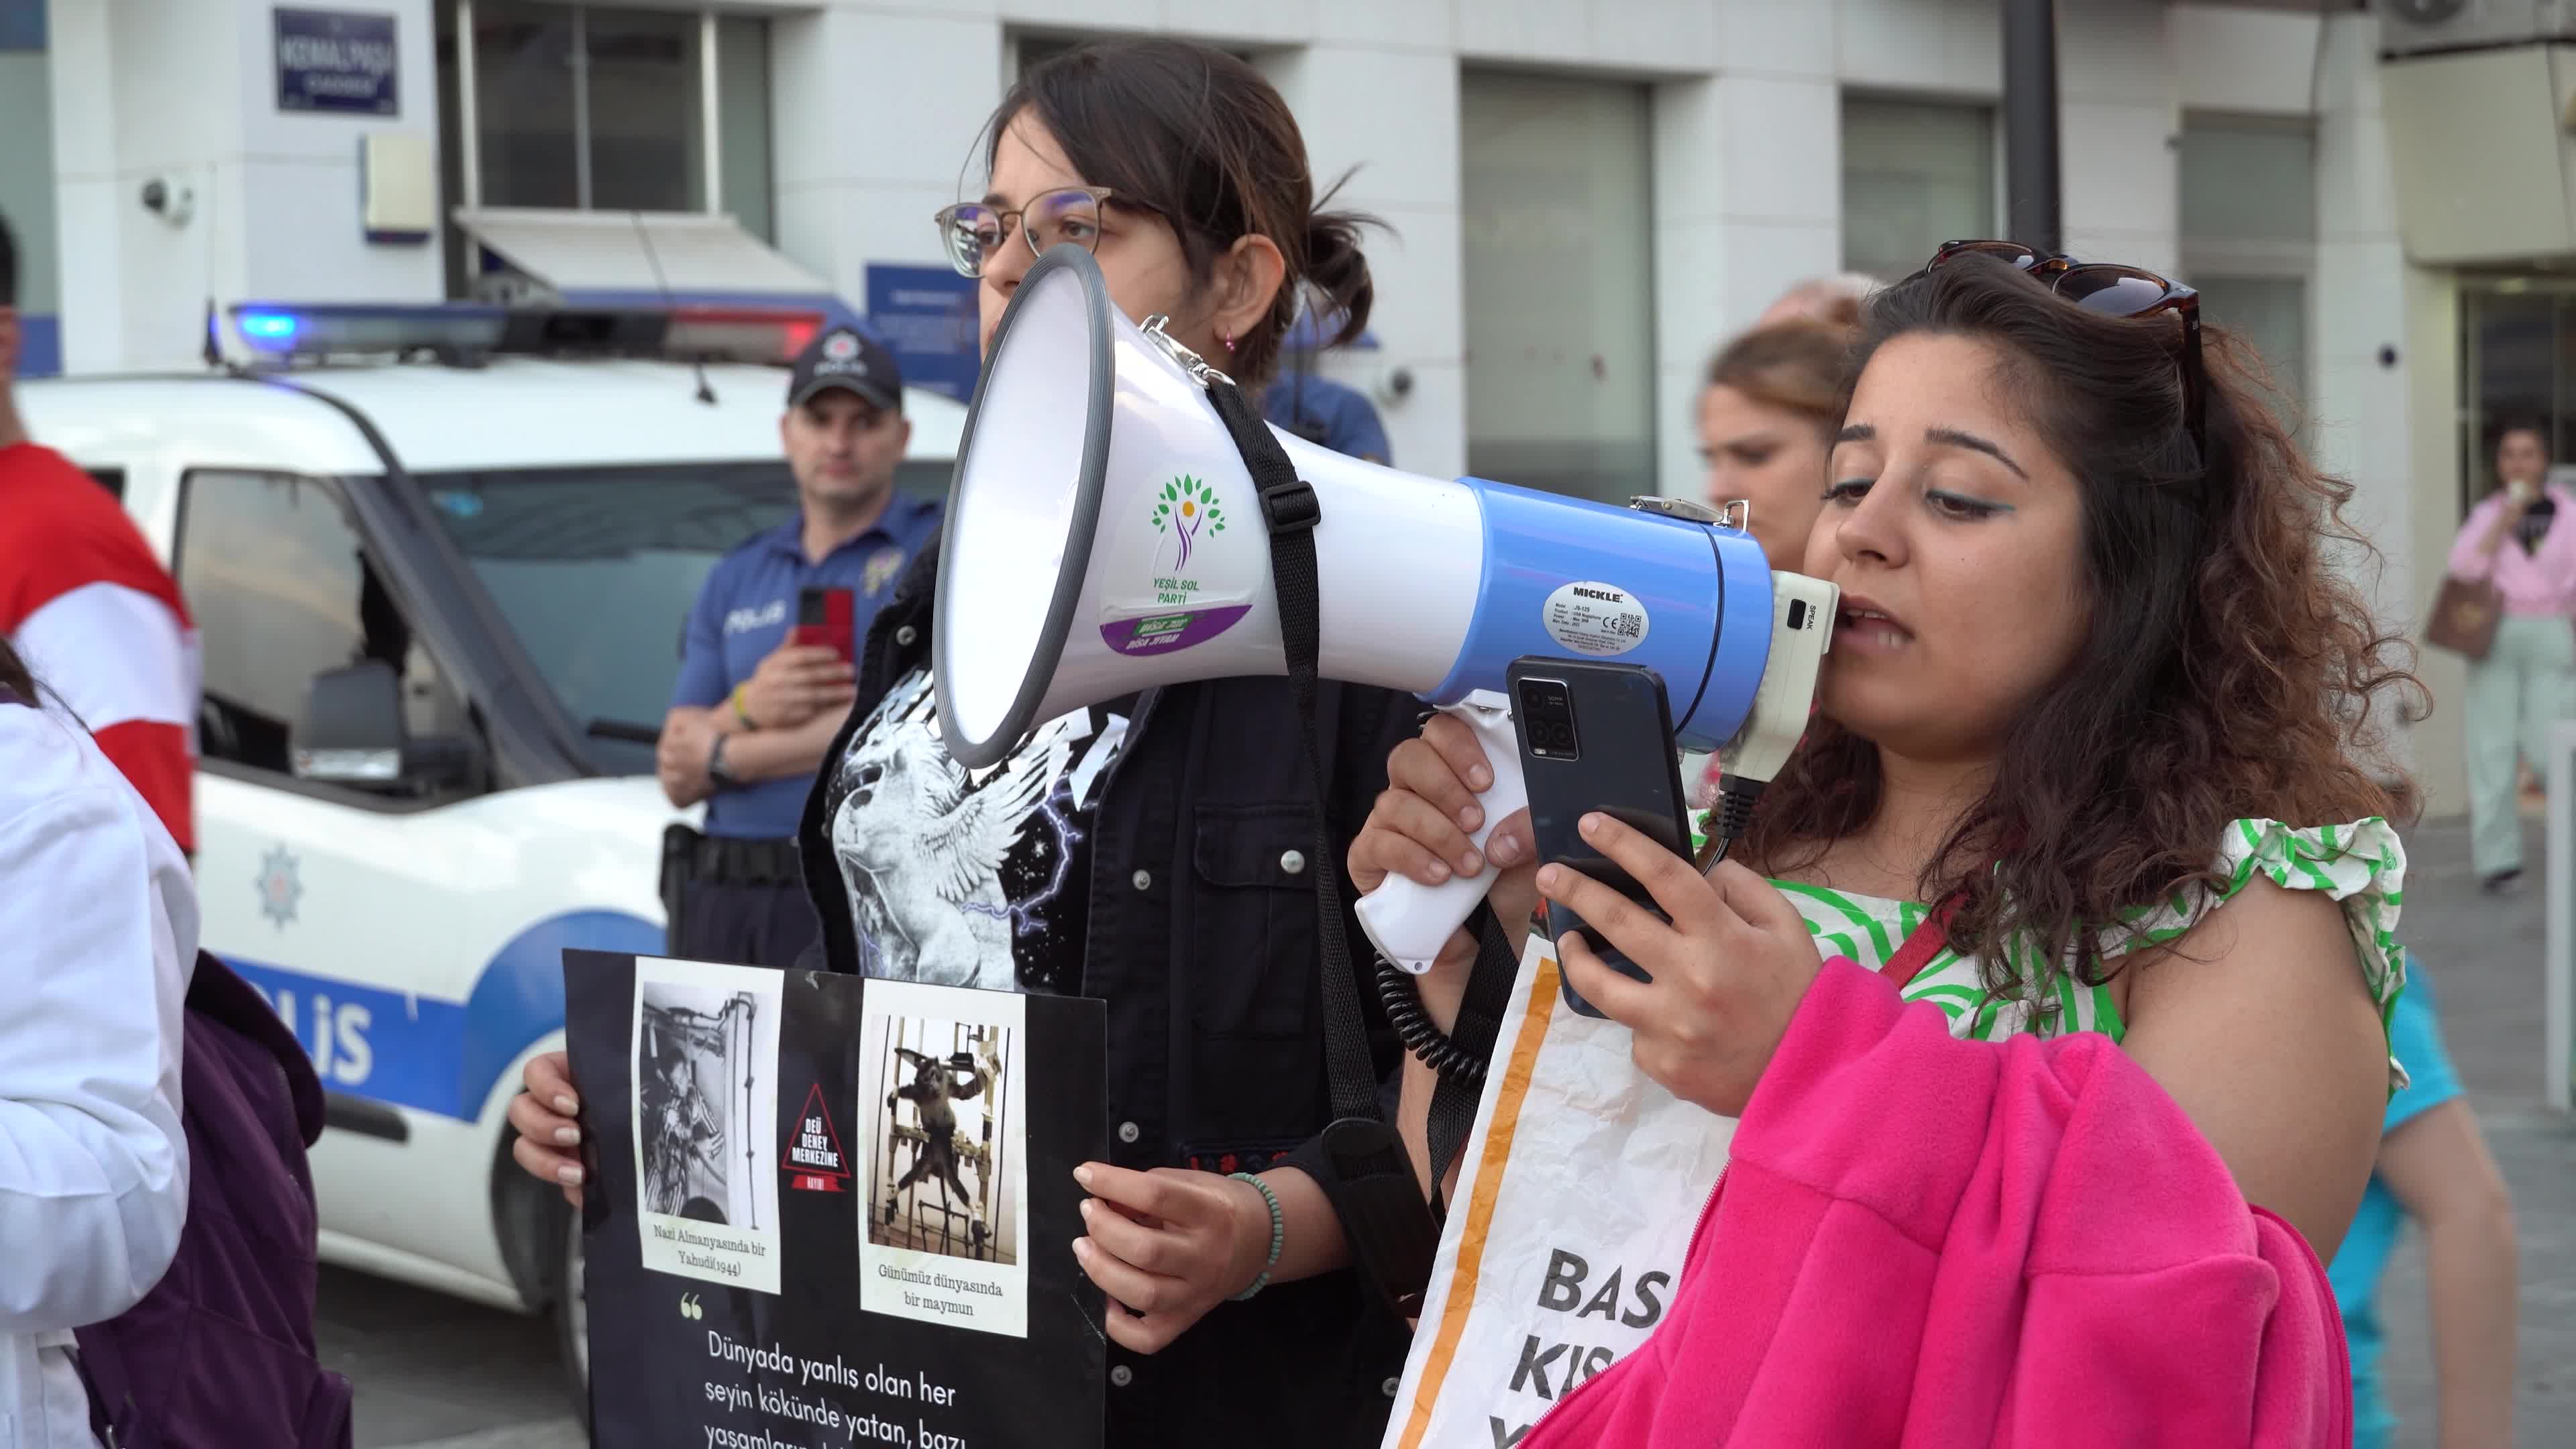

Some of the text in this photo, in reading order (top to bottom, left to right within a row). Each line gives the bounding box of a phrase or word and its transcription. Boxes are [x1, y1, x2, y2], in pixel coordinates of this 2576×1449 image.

[1154, 576, 1199, 591] YEŞİL SOL
[1158, 590, 1186, 604] PARTİ
[1806, 605, 1816, 630] SPEAK
[805, 1116, 822, 1134] DEÜ
[802, 1133, 828, 1151] DENEY
[653, 1224, 767, 1256] Nazi Almanyasında bir
[678, 1250, 741, 1277] Yahudi(1944)
[879, 1264, 1004, 1297] Günümüz dünyasında
[904, 1291, 974, 1316] bir maymun
[708, 1330, 794, 1374] Dünyada
[865, 1363, 912, 1399] olan
[920, 1371, 956, 1407] her
[757, 1383, 841, 1428] kökünde
